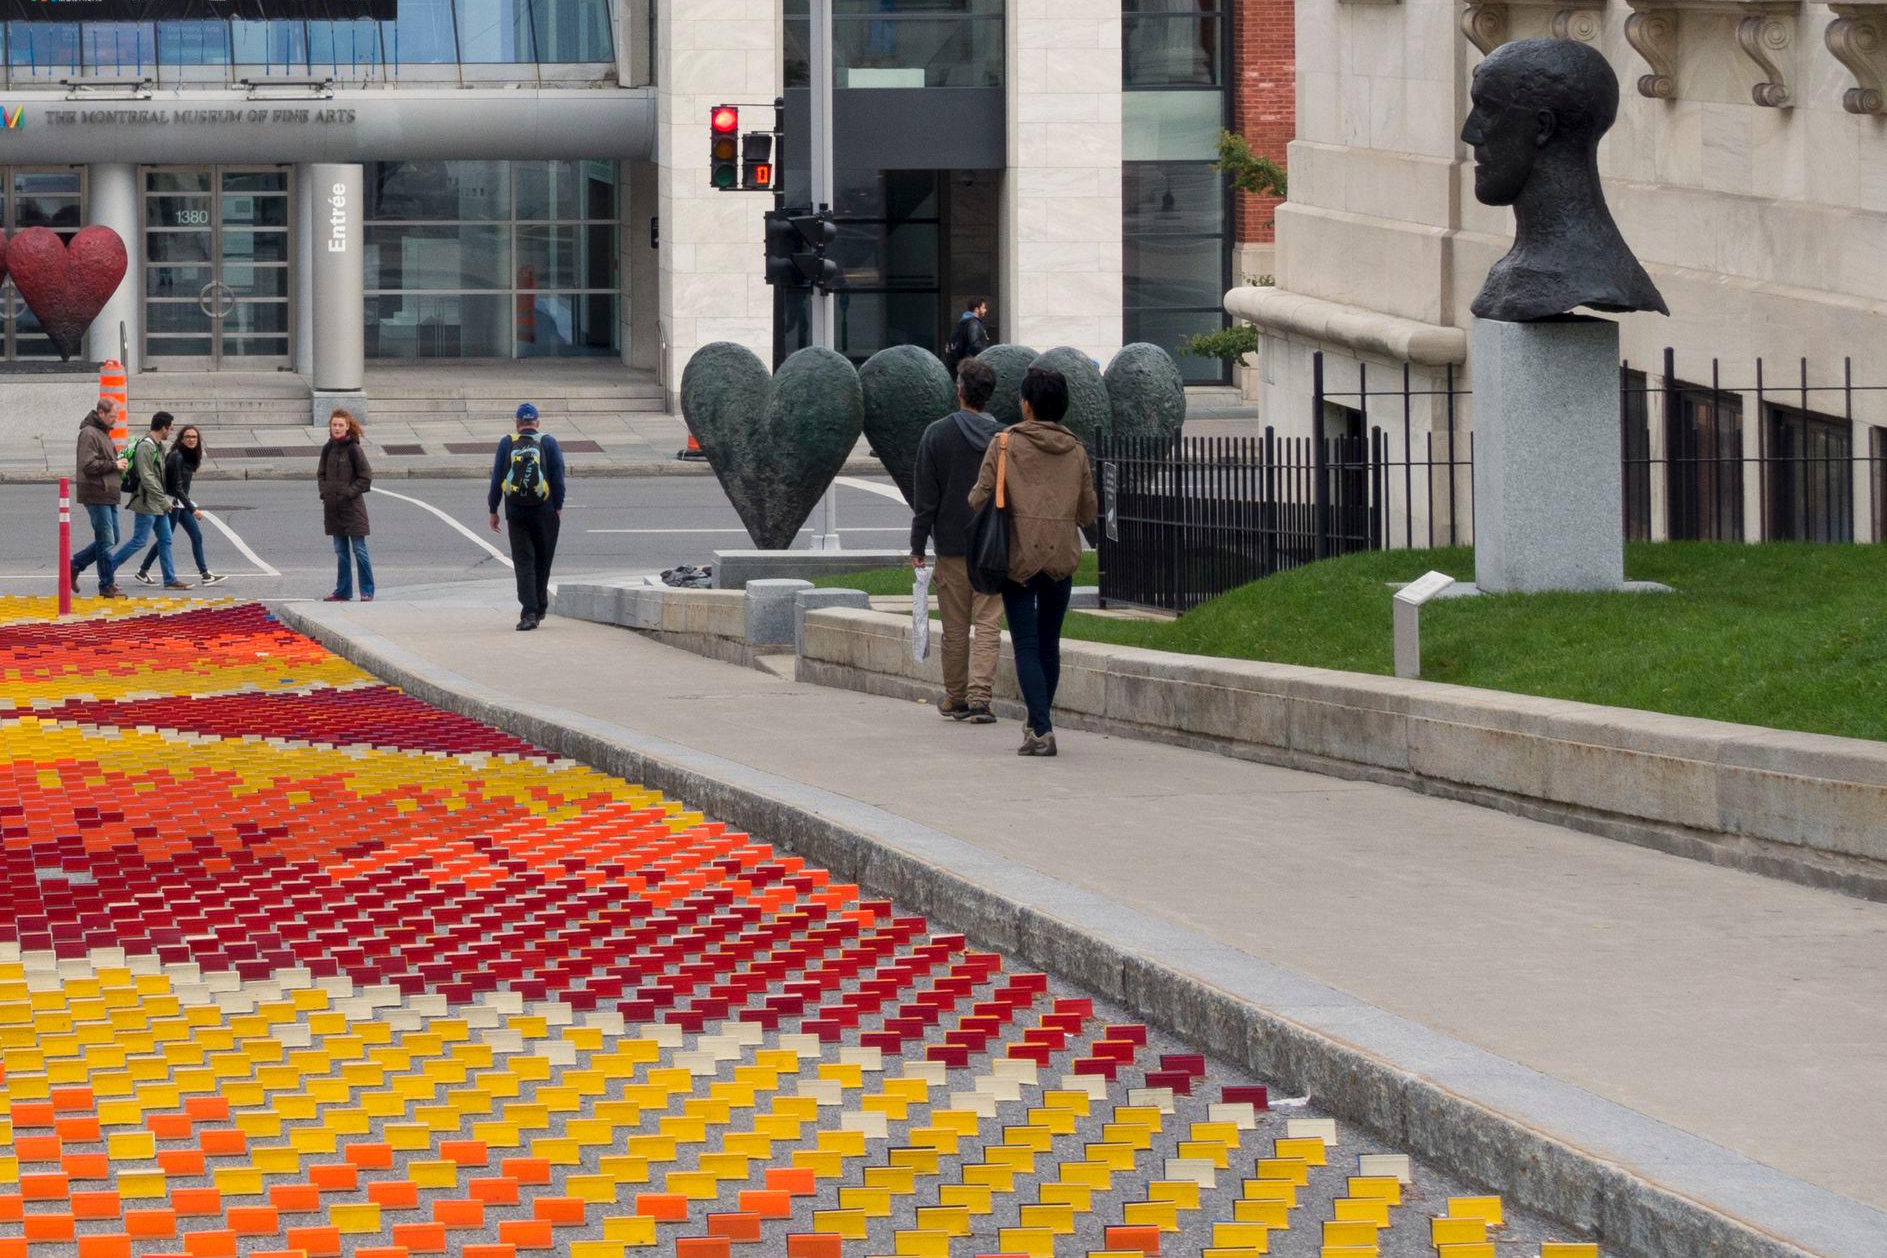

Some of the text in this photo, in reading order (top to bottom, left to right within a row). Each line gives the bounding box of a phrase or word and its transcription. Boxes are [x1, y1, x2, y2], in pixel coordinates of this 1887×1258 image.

[45, 110, 75, 124] THE
[173, 110, 242, 123] MUSEUM
[246, 109, 267, 123] OF
[271, 109, 310, 123] FINE
[315, 109, 356, 123] ARTS
[756, 165, 769, 184] 0
[175, 210, 208, 224] 1380
[328, 182, 346, 253] Entrée
